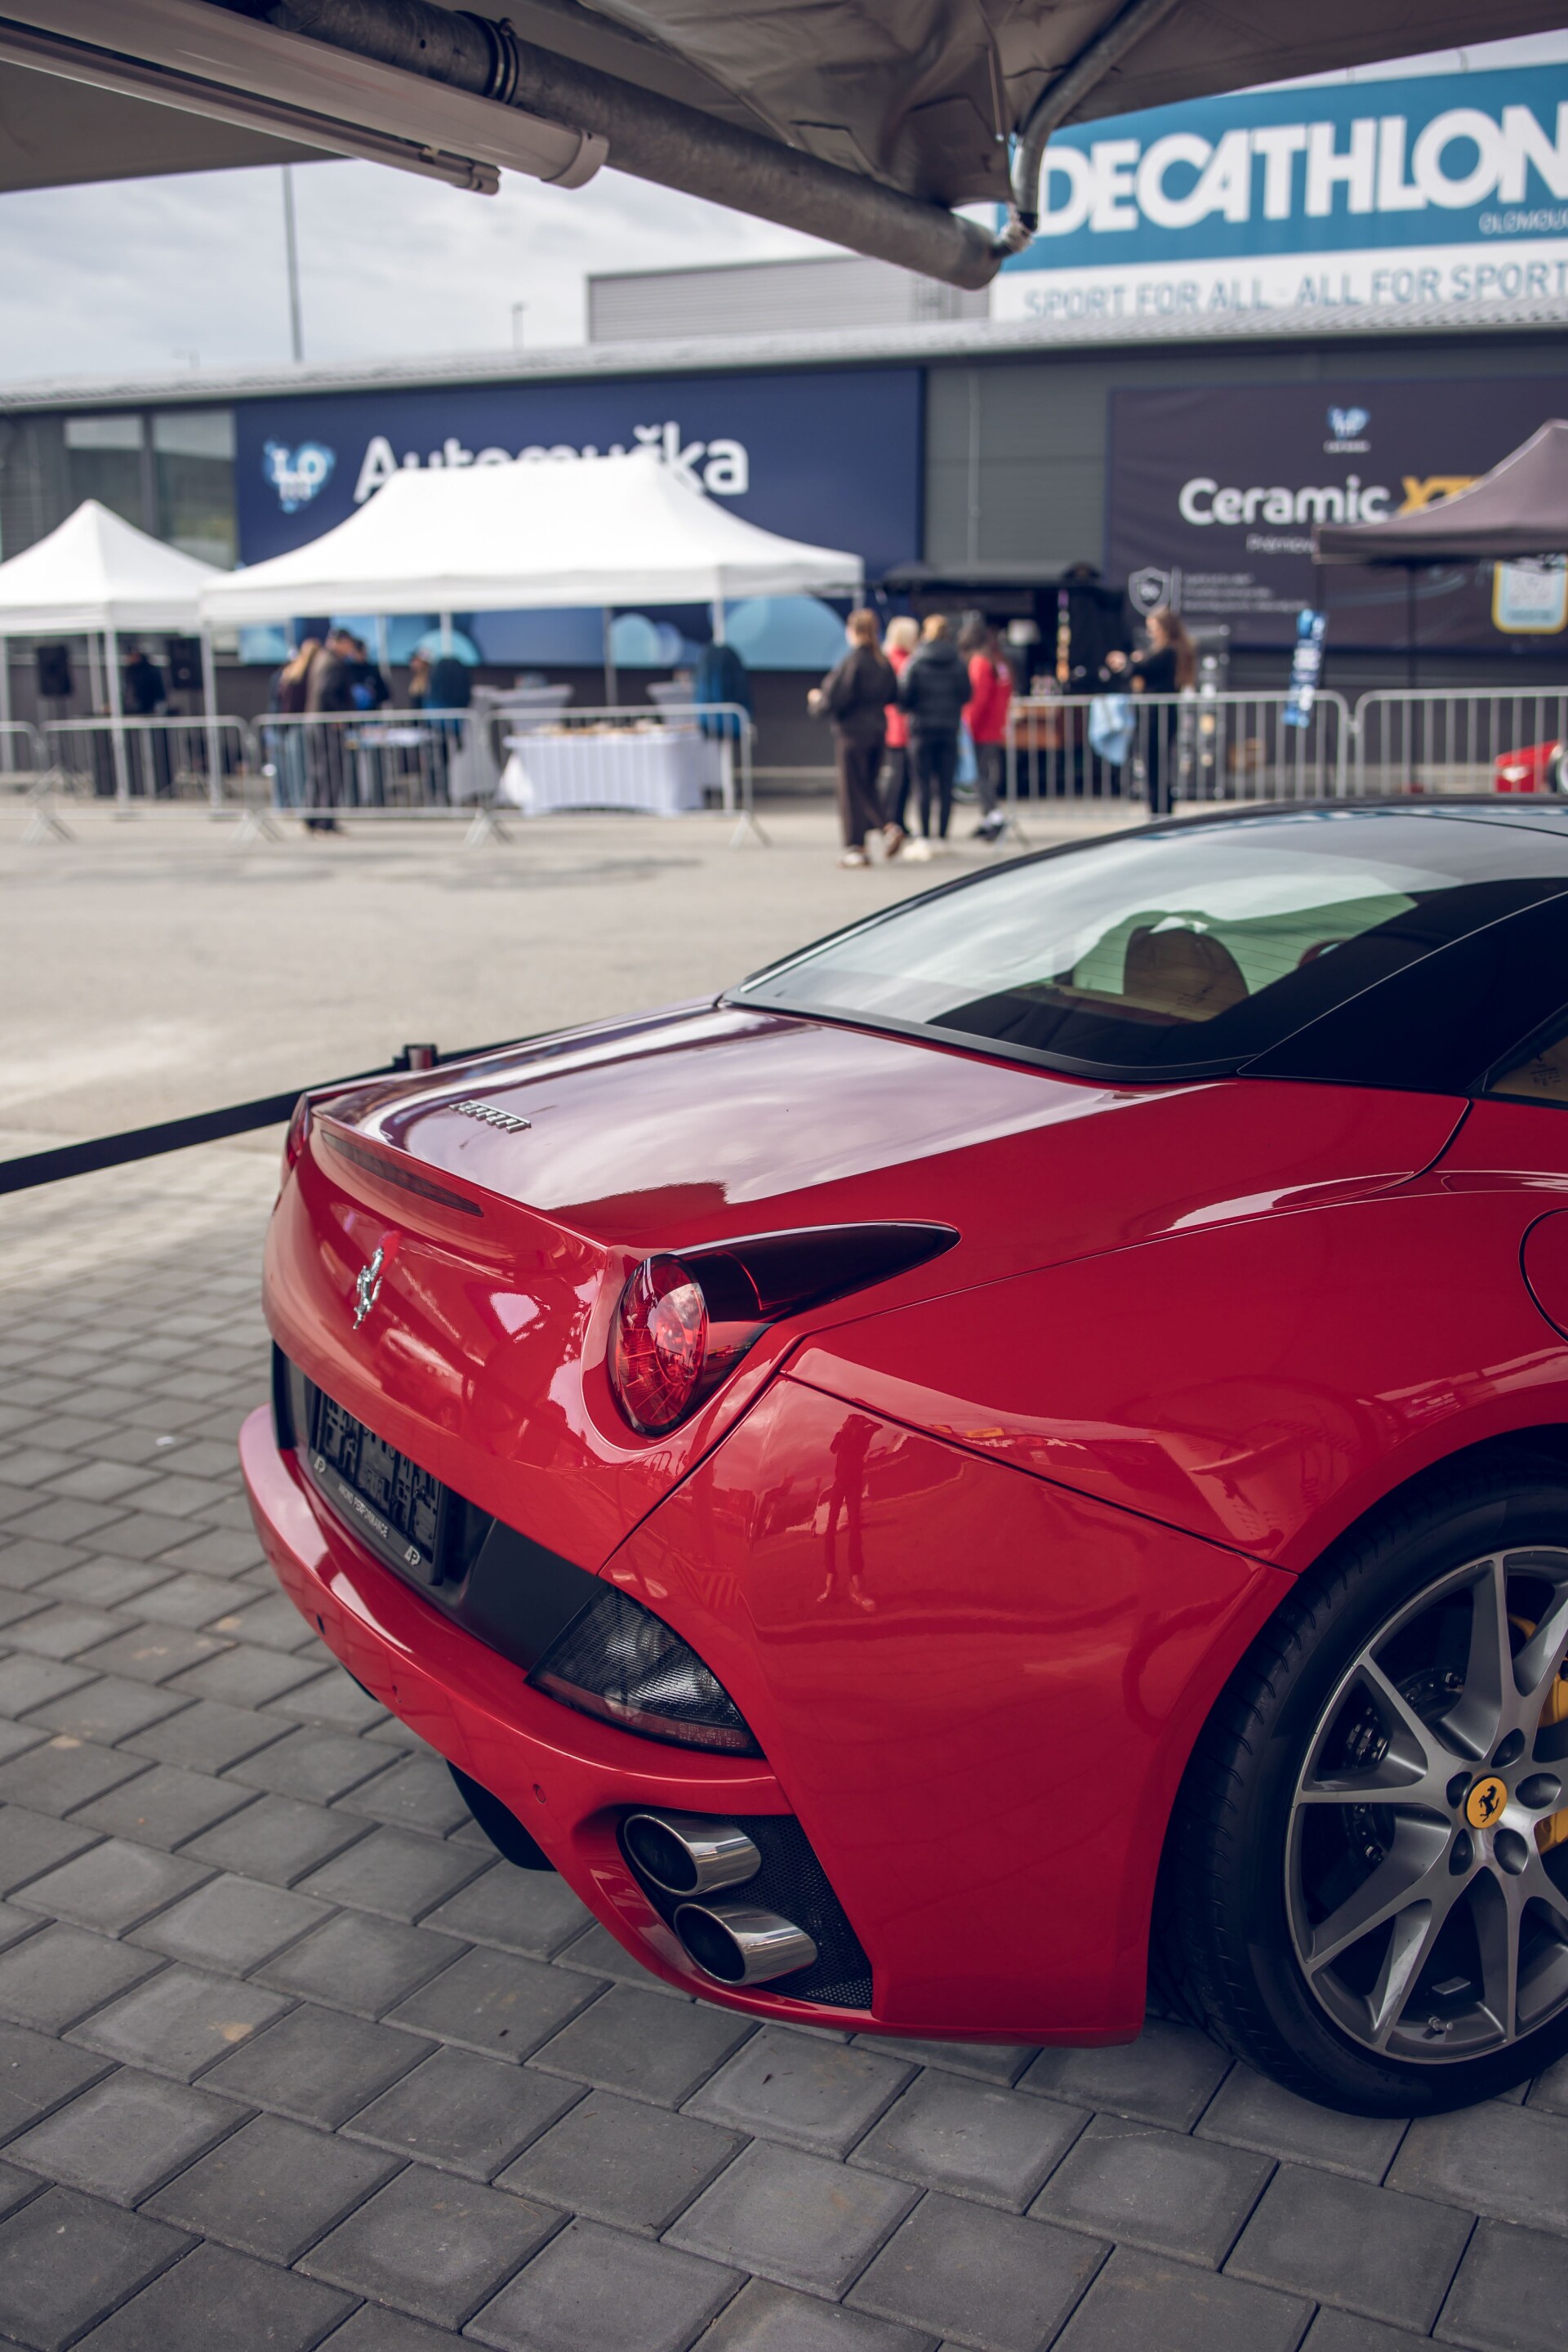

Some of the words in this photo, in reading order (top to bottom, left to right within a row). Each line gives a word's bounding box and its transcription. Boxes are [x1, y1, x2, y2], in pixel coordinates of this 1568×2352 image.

[1038, 102, 1568, 236] DECATHLON
[1023, 283, 1126, 319] SPORT
[1136, 278, 1200, 316] FOR
[1209, 276, 1271, 311] ALL
[1295, 272, 1361, 306] ALL
[1371, 267, 1442, 305] FOR
[1450, 259, 1568, 302] SPORT
[1178, 474, 1391, 526] Ceramic
